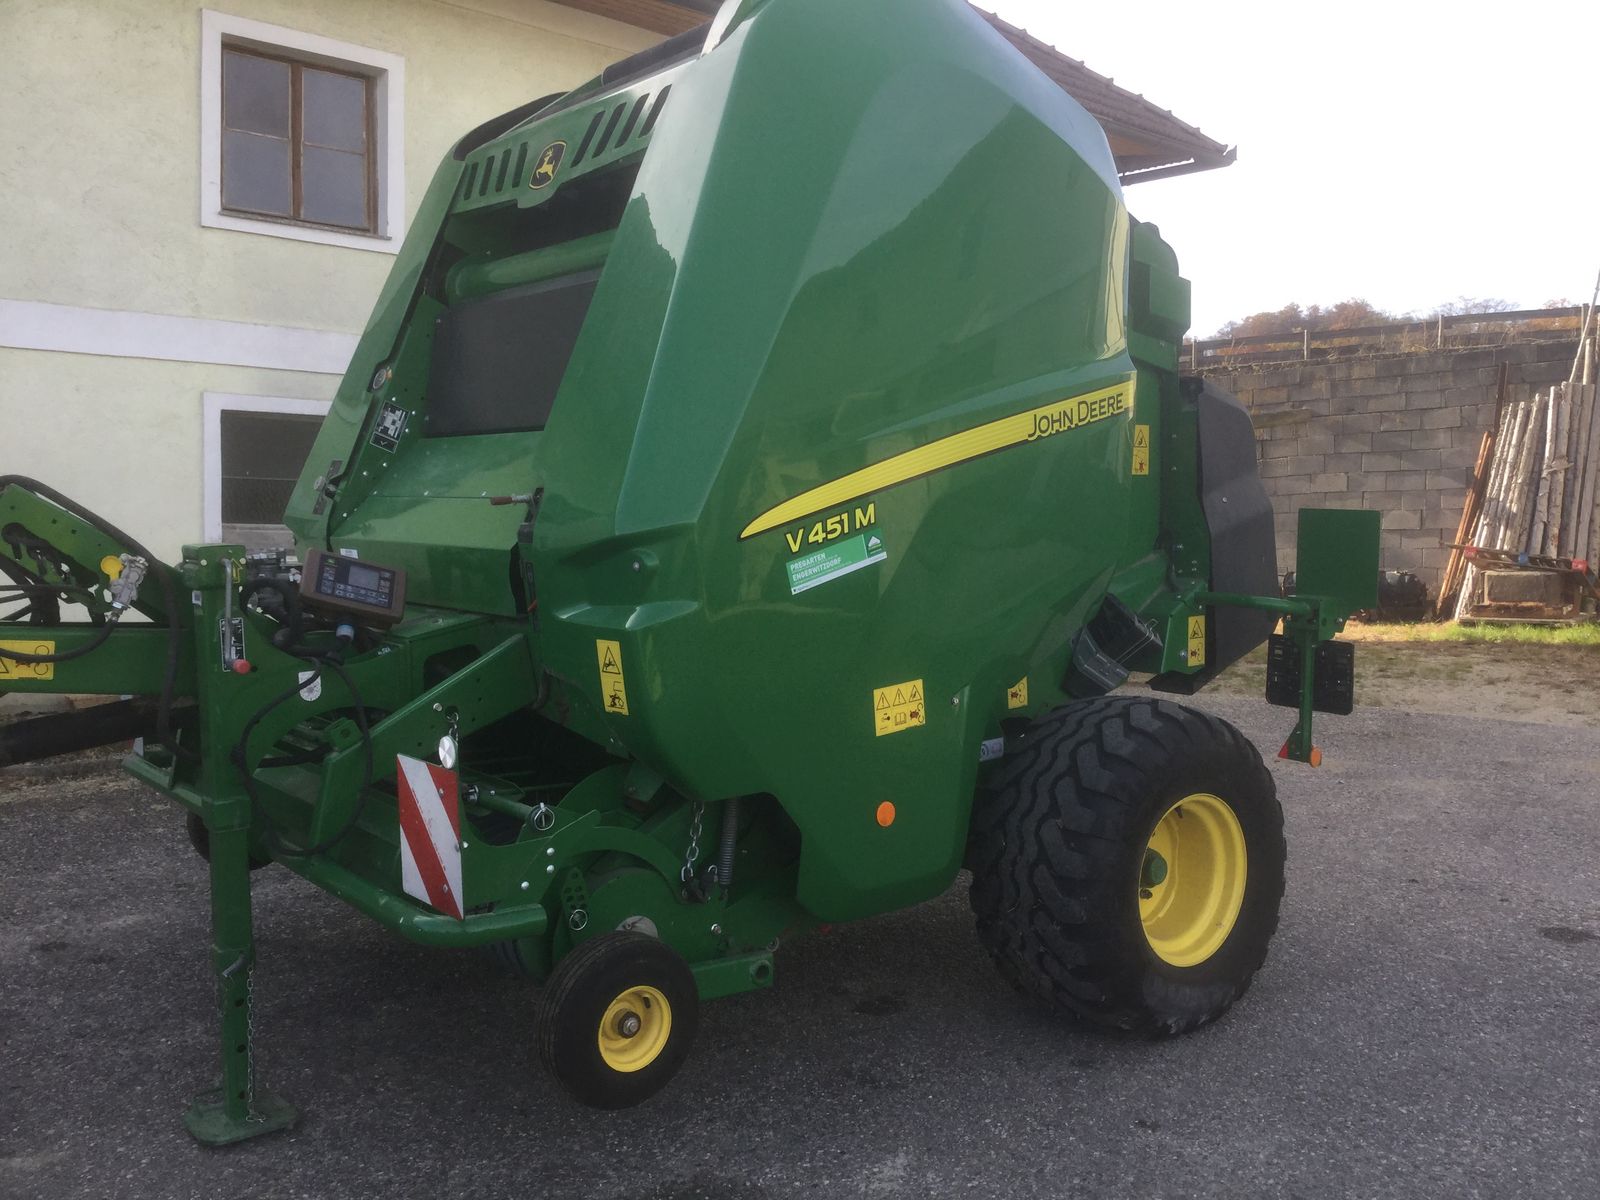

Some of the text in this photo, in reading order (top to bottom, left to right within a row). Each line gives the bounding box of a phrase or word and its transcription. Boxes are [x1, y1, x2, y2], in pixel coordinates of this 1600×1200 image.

[1028, 393, 1123, 438] JOHN DEERE
[785, 503, 875, 553] V 451 M
